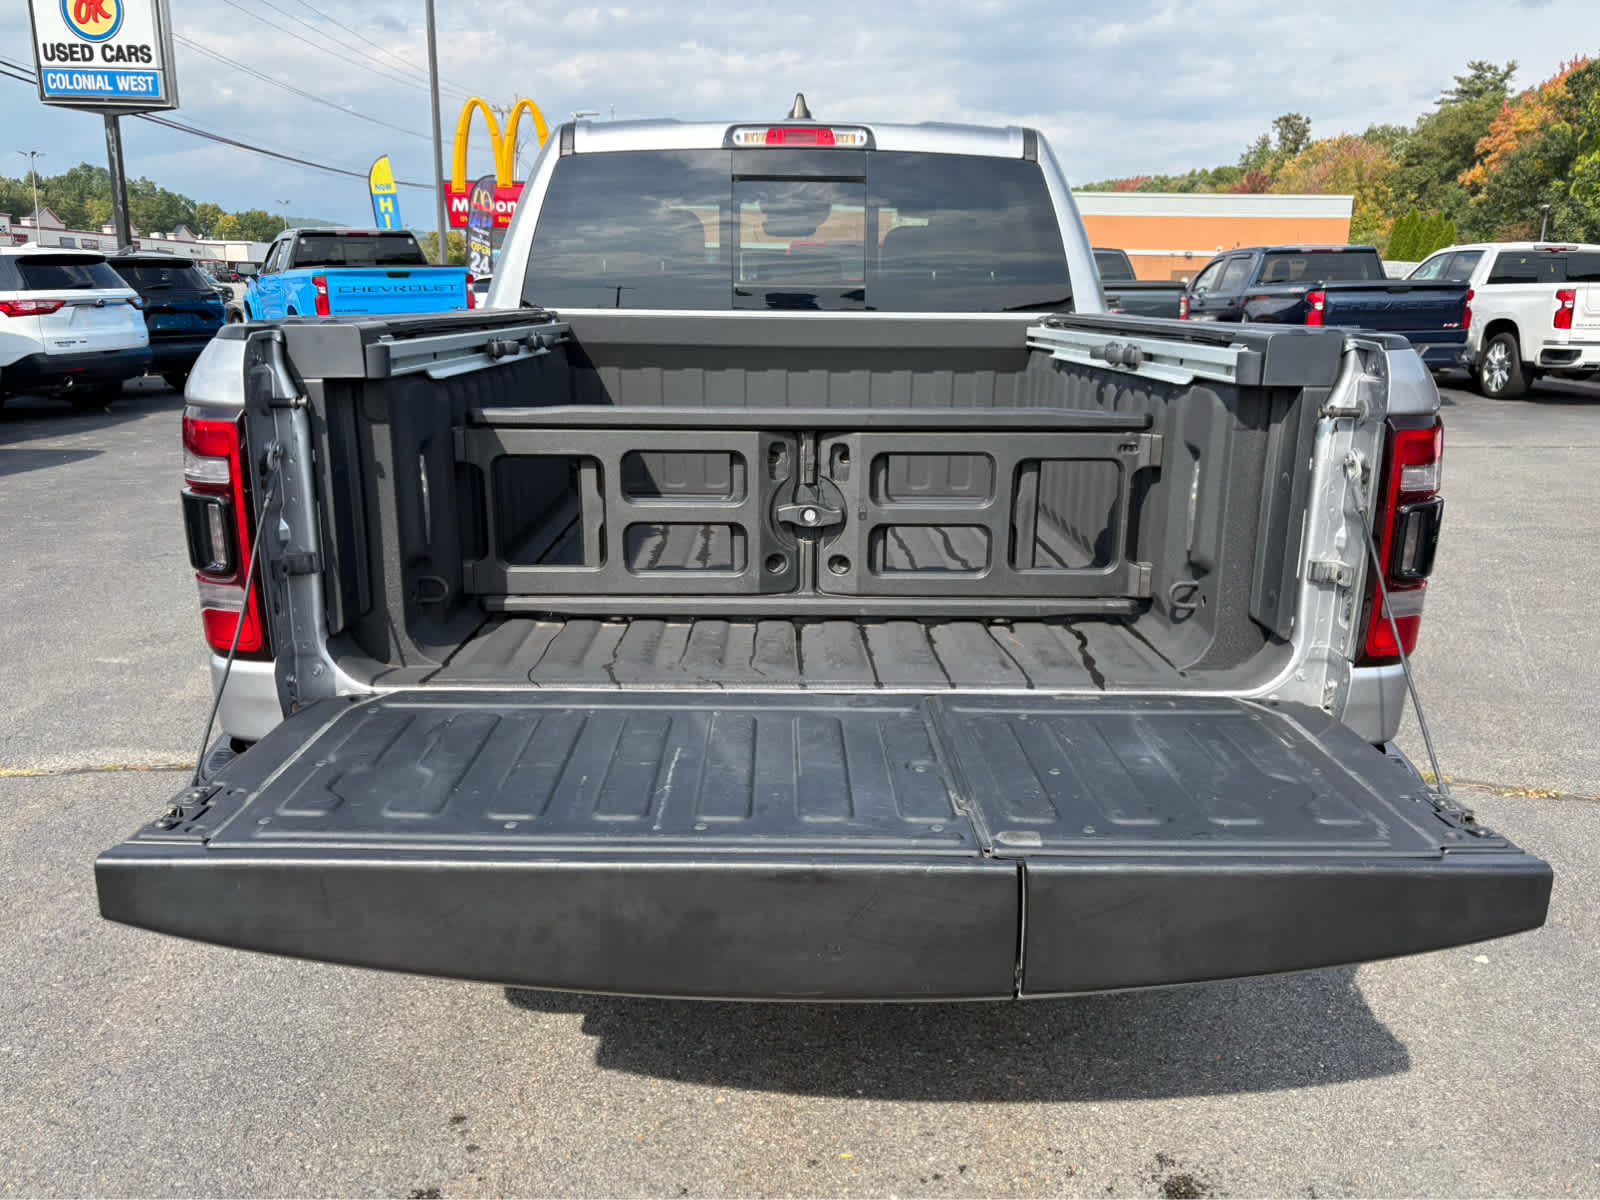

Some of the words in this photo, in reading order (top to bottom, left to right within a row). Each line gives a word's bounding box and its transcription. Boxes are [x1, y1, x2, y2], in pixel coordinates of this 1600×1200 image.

[73, 0, 112, 24] OK
[42, 43, 94, 62] USED
[101, 44, 152, 63] CARS
[47, 73, 113, 91] COLONIAL
[116, 75, 154, 92] WEST
[471, 241, 491, 256] OPEN
[470, 251, 490, 274] 24
[338, 284, 457, 294] CHEVROLET
